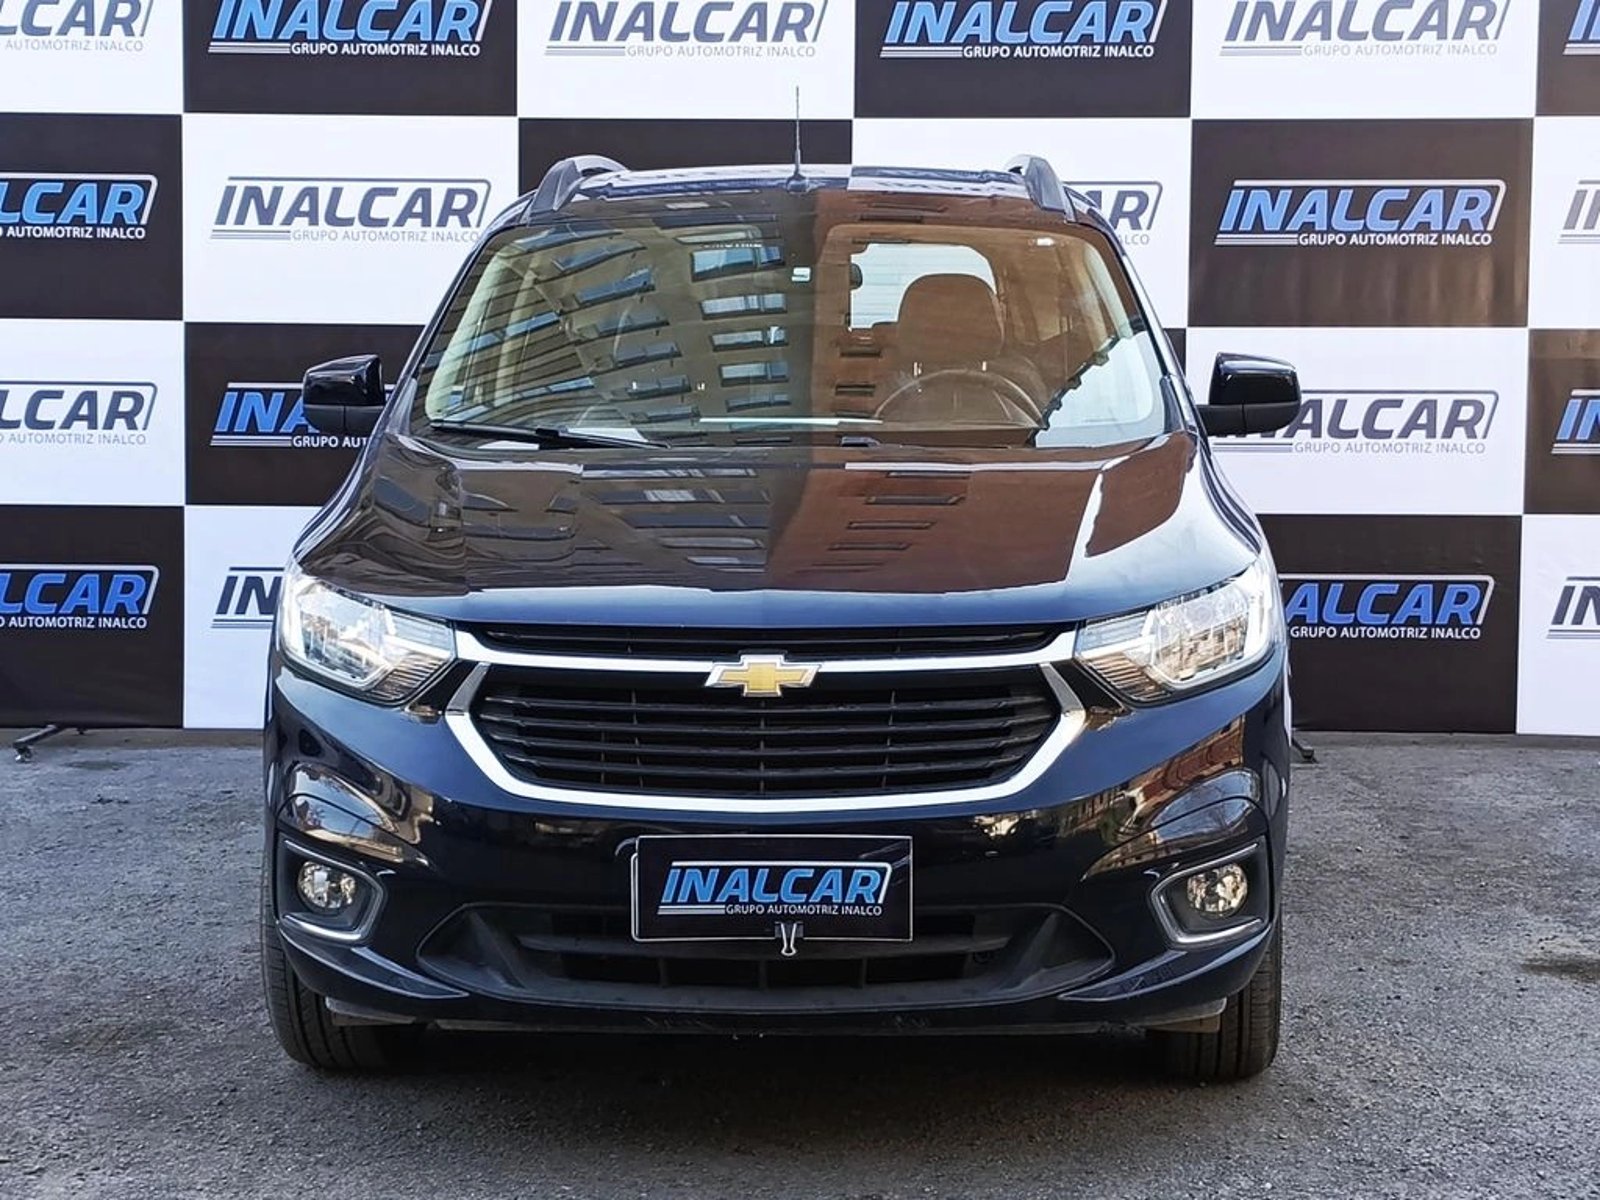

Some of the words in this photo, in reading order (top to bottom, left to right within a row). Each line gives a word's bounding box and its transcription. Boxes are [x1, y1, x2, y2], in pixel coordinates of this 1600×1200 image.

[212, 0, 480, 41] INALCAR
[549, 1, 815, 43] INALCAR
[885, 1, 1155, 43] INALCAR
[1225, 0, 1498, 41] INALCAR
[6, 40, 91, 51] AUTOMOTRIZ
[95, 41, 144, 52] INALCO
[292, 43, 338, 55] GRUPO
[342, 43, 427, 55] AUTOMOTRIZ
[431, 44, 480, 56] INALCO
[627, 45, 673, 57] GRUPO
[677, 45, 763, 57] AUTOMOTRIZ
[767, 46, 816, 58] INALCO
[963, 45, 1010, 57] GRUPO
[1013, 45, 1100, 57] AUTOMOTRIZ
[1104, 46, 1154, 58] INALCO
[1304, 44, 1350, 56] GRUPO
[1355, 44, 1444, 56] AUTOMOTRIZ
[1448, 45, 1497, 57] INALCO
[214, 185, 478, 228] INALCAR
[1219, 189, 1492, 231] INALCAR
[6, 226, 93, 238] AUTOMOTRIZ
[97, 227, 146, 239] INALCO
[293, 230, 338, 242] GRUPO
[342, 230, 428, 242] AUTOMOTRIZ
[431, 231, 480, 243] INALCO
[1299, 233, 1345, 246] GRUPO
[1349, 233, 1438, 246] AUTOMOTRIZ
[1441, 234, 1492, 247] INALCO
[0, 389, 145, 431] LCAR
[1216, 399, 1486, 439] ALCAR
[8, 433, 95, 444] AUTOMOTRIZ
[98, 434, 147, 445] INALCO
[292, 436, 339, 448] GRUPO
[1295, 442, 1341, 453] GRUPO
[1344, 442, 1432, 453] AUTOMOTRIZ
[1435, 443, 1486, 454] INALCO
[0, 572, 147, 615] LCAR
[8, 616, 95, 628] AUTOMOTRIZ
[98, 617, 148, 629] INALCO
[1290, 626, 1337, 638] GRUPO
[1340, 626, 1428, 638] AUTOMOTRIZ
[1431, 627, 1481, 639] INALCO
[660, 868, 882, 904] INALCAR
[726, 904, 765, 915] GRUPO
[767, 904, 839, 915] AUTOMOTRIZ
[841, 905, 882, 916] INALCO
